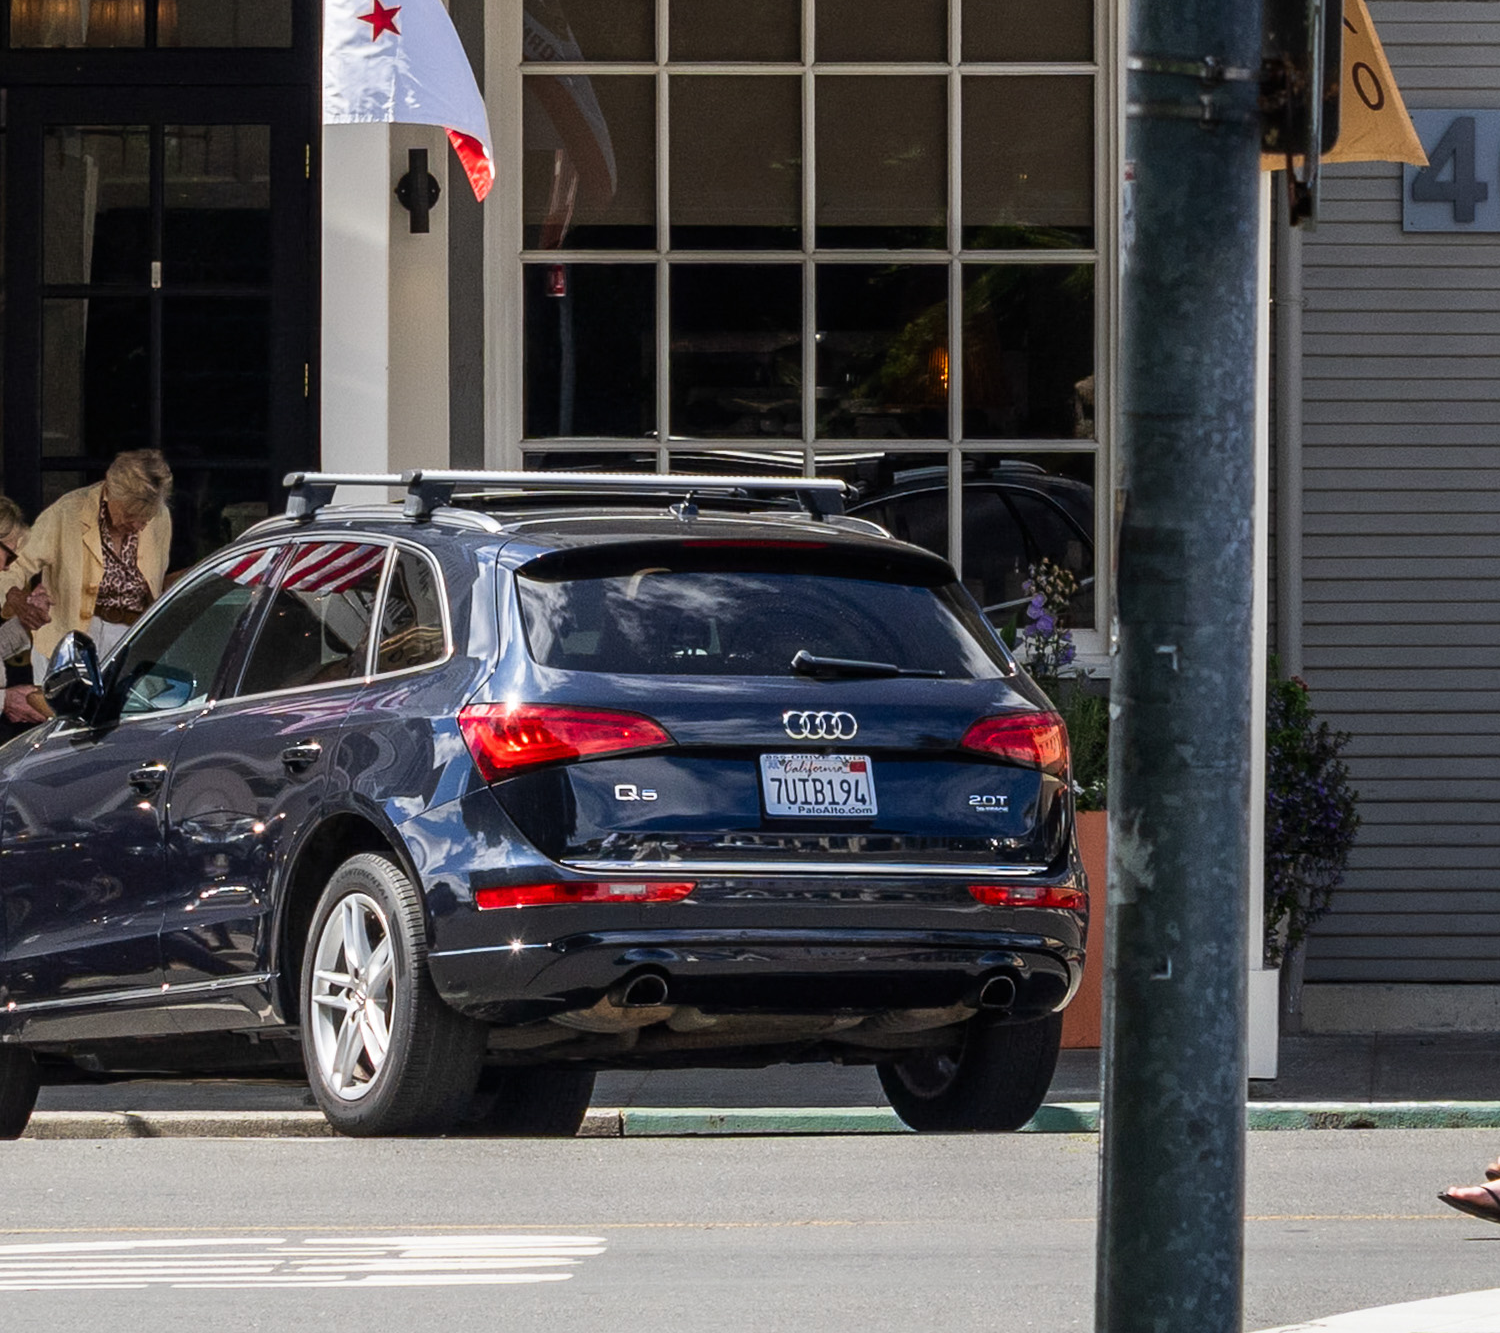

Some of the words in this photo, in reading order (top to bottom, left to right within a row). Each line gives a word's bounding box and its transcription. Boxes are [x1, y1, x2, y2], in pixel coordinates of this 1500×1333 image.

[784, 760, 847, 778] California
[614, 783, 658, 802] Q5
[769, 777, 868, 806] 7UIB194
[797, 806, 874, 815] PaloAlto.com
